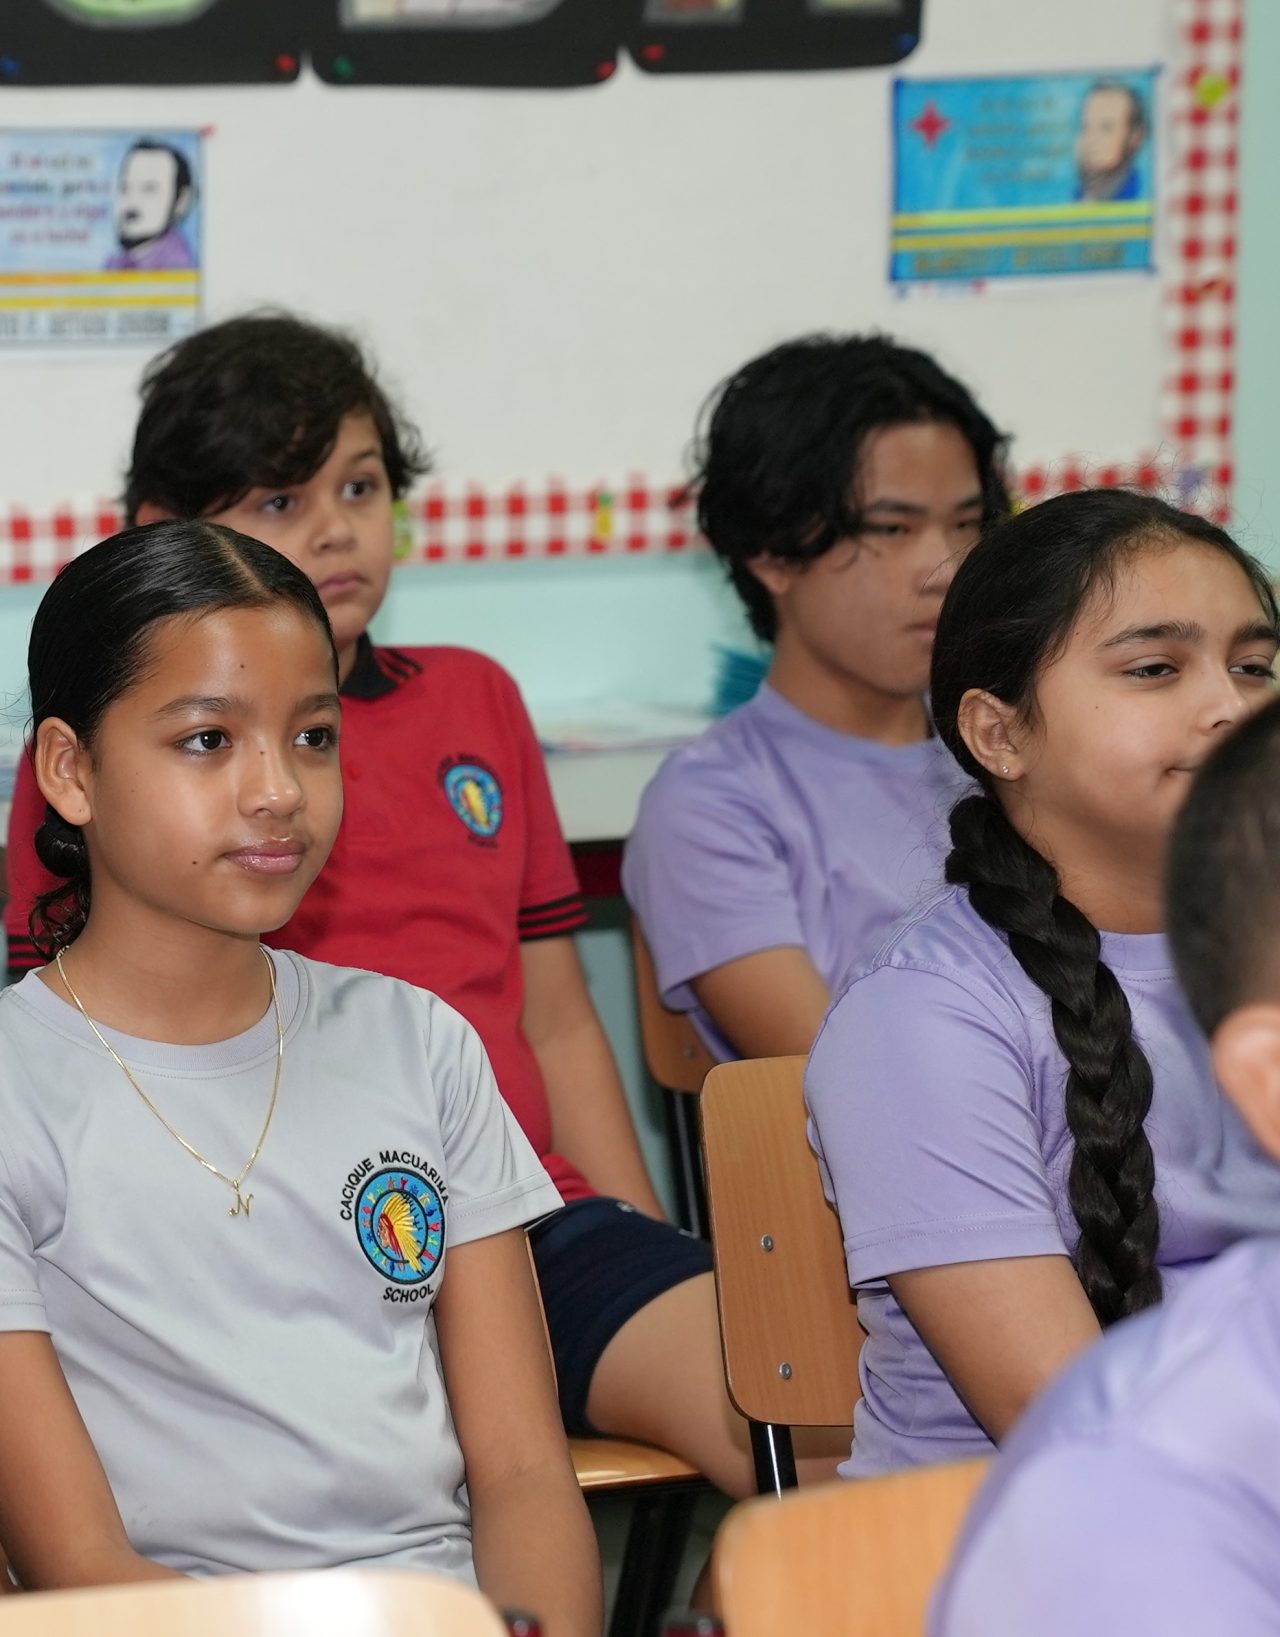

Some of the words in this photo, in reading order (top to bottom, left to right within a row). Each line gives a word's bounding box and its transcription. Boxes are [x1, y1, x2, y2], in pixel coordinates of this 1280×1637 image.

[340, 1158, 375, 1221] CACIQUE
[379, 1150, 449, 1206] MACUARIMA
[383, 1283, 434, 1303] SCHOOL
